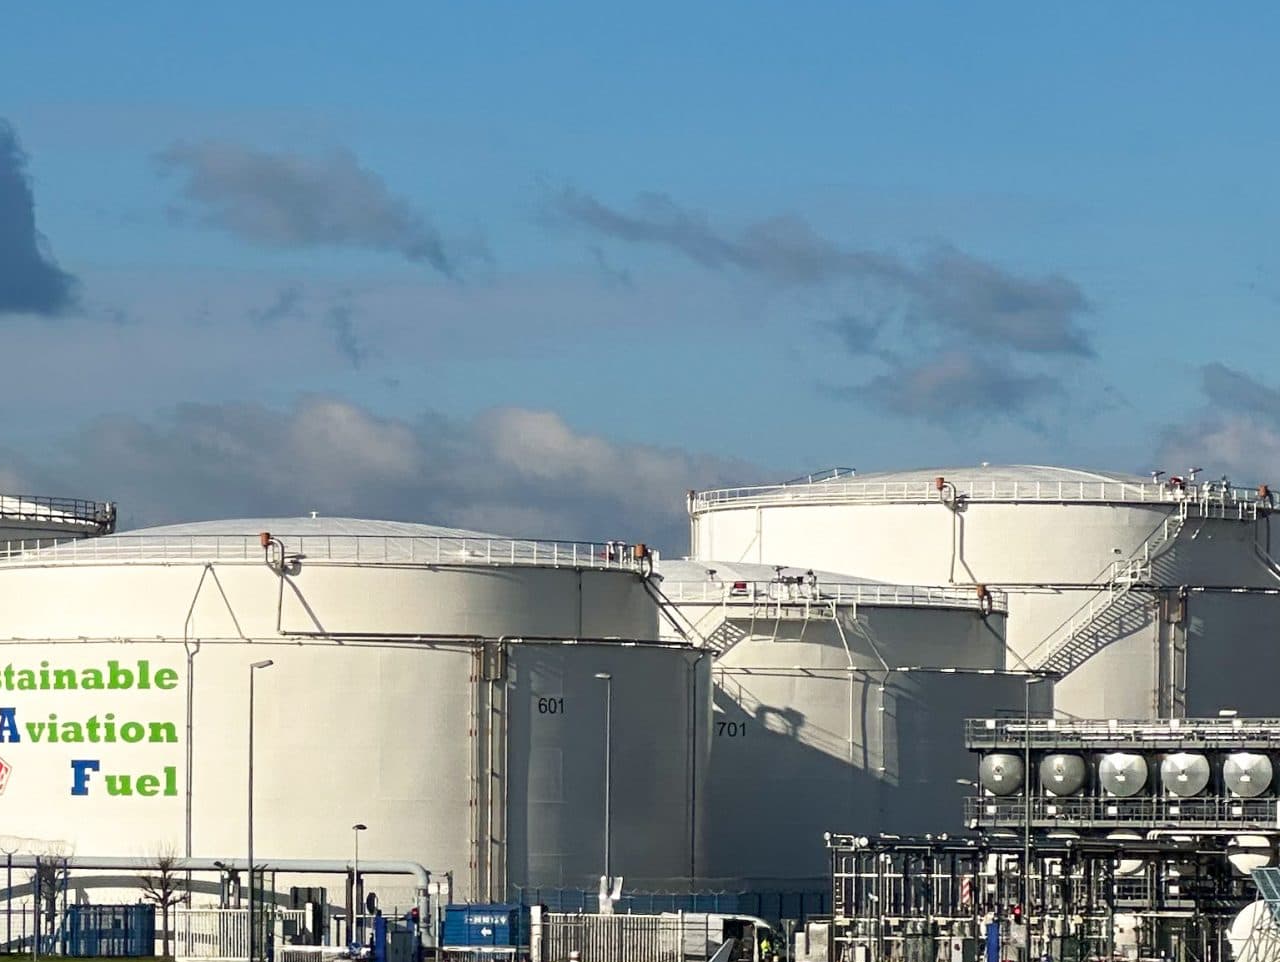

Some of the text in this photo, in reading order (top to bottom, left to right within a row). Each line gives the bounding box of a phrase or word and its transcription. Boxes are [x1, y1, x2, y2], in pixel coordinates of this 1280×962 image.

[538, 697, 565, 715] 601
[717, 722, 747, 737] 701
[71, 759, 178, 796] Fuel
